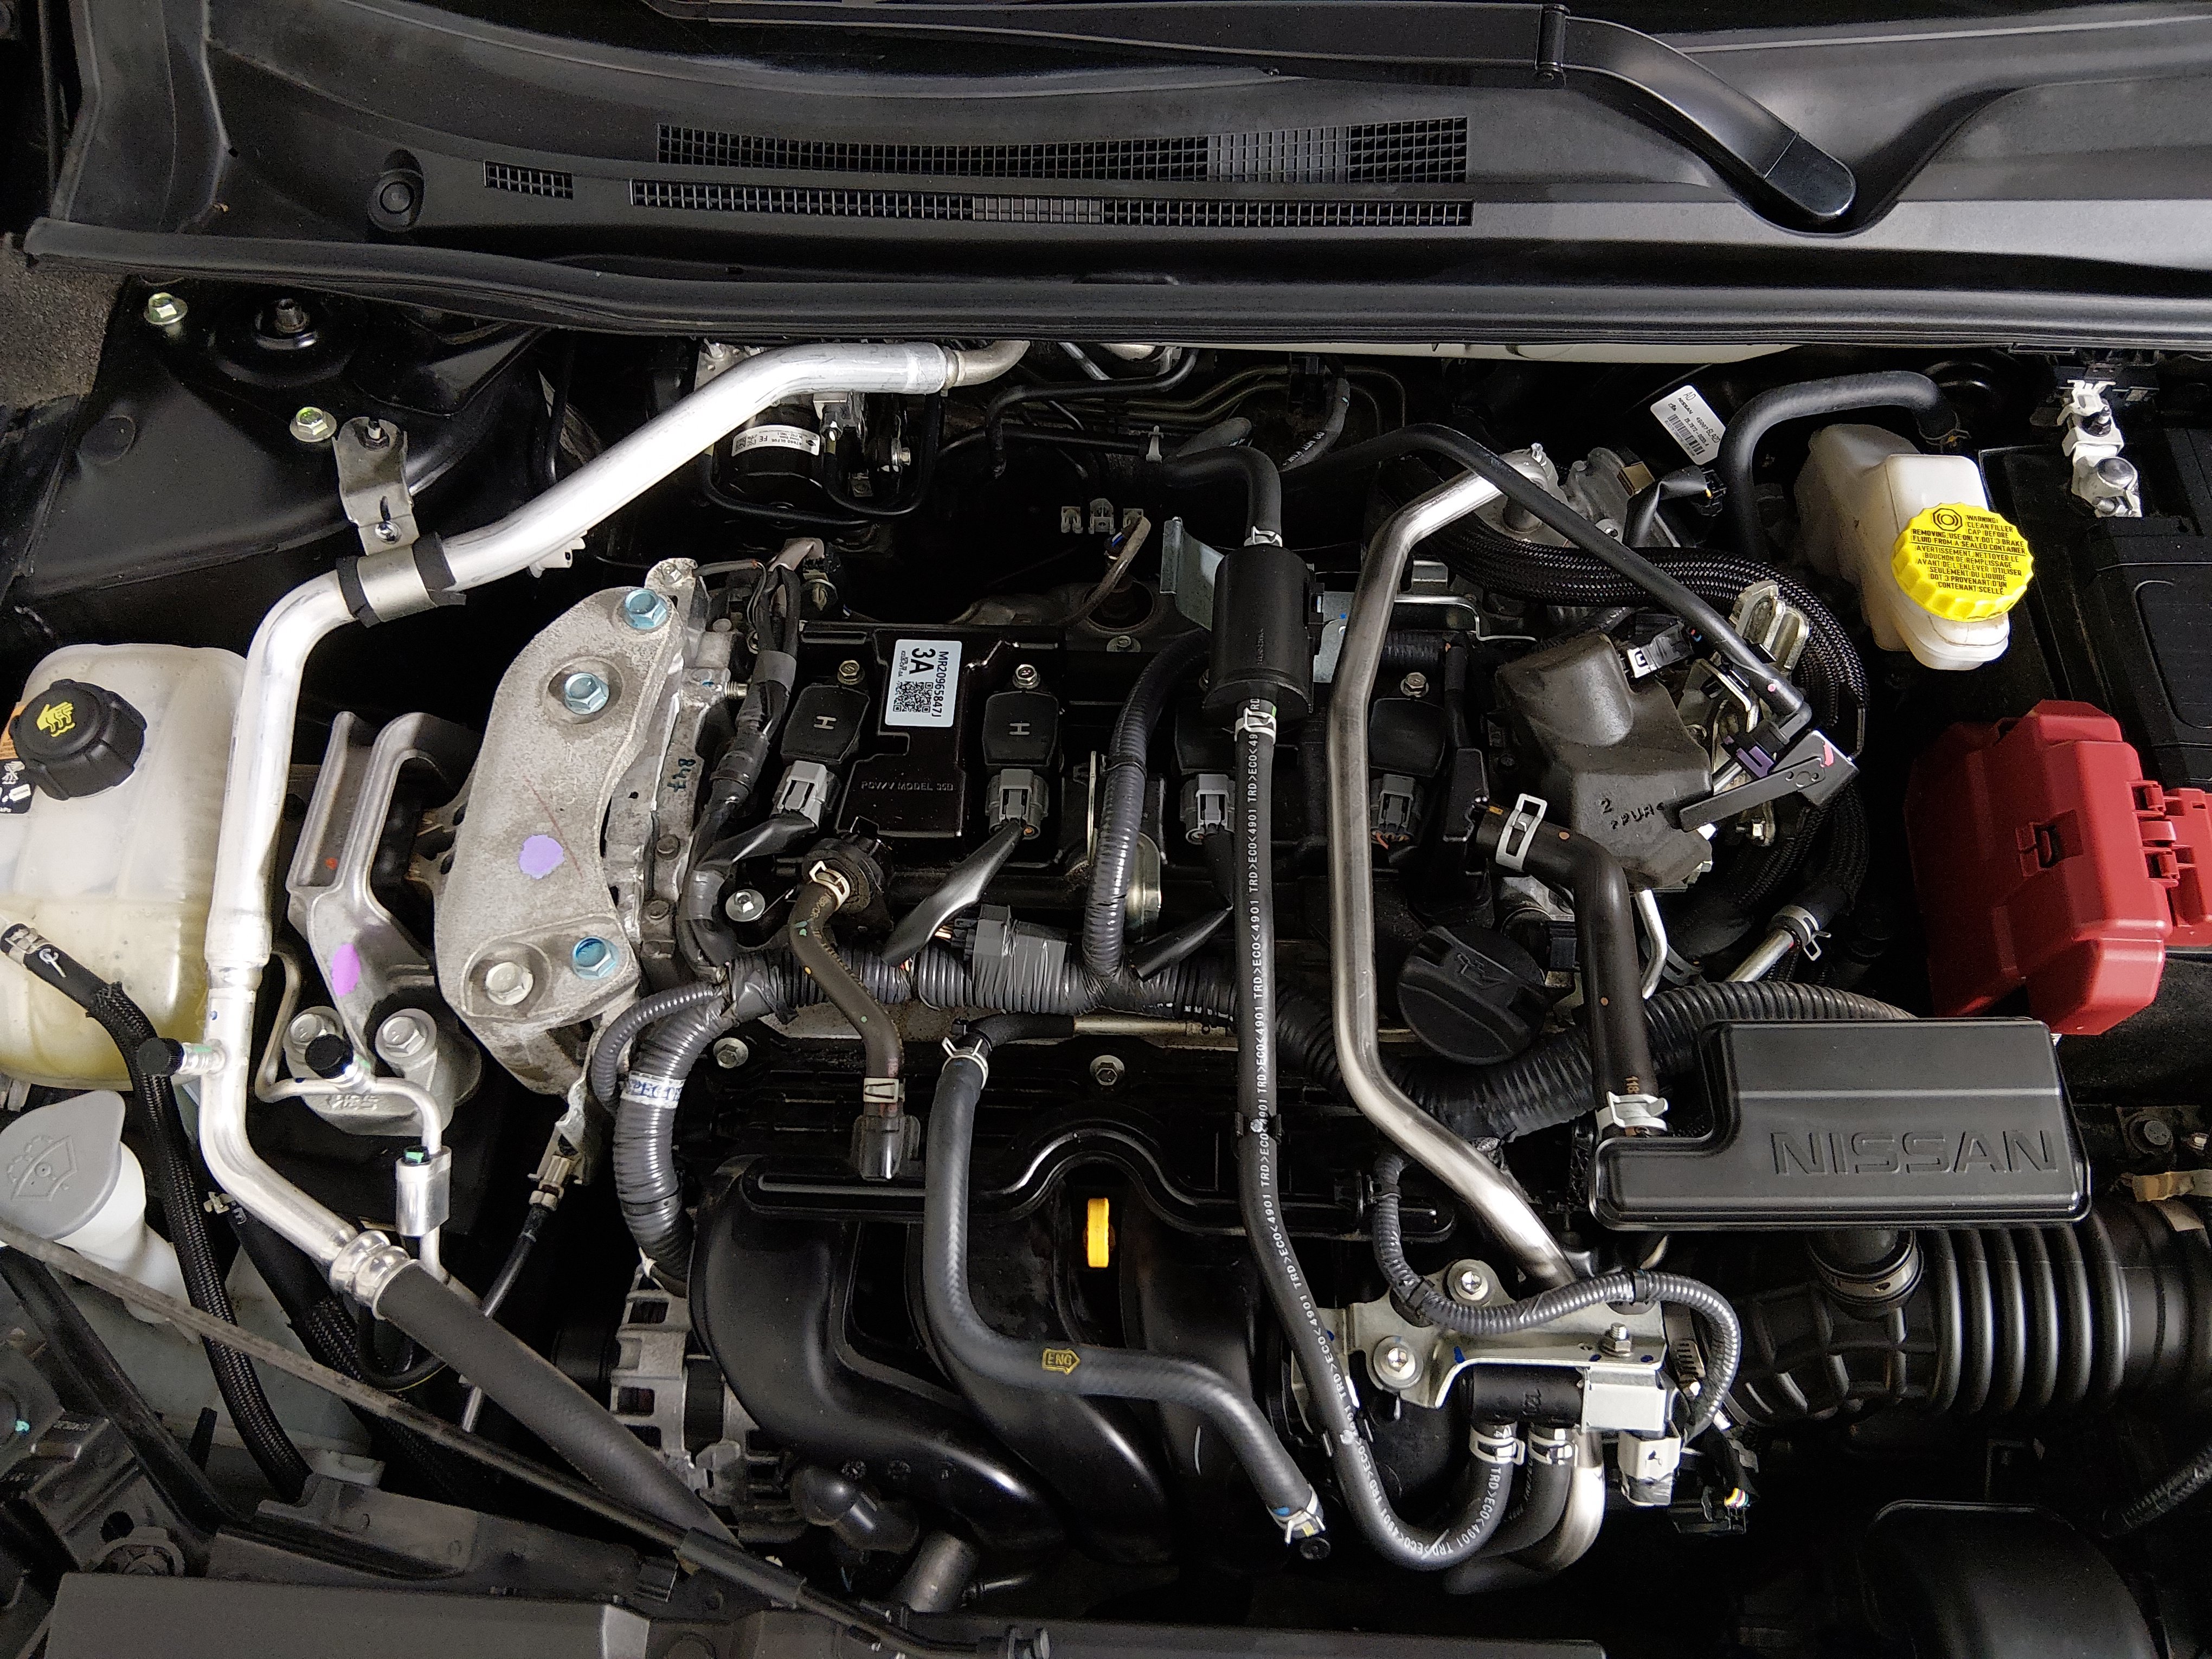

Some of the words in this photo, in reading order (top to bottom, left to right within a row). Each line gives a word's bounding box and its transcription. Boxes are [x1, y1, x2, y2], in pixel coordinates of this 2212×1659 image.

[1677, 397, 1693, 415] NISSAN
[1984, 530, 2009, 539] BEFORE
[1991, 524, 2014, 532] FILLER
[1912, 535, 1932, 543] FLUID
[1962, 541, 1988, 550] SEALED
[2002, 539, 2024, 548] BRAKE
[1925, 552, 1954, 562] BOUCHON
[1966, 557, 2012, 569] REMPLISSAGE
[1975, 551, 2009, 561] NETTOYER
[1917, 558, 1940, 567] AVANT
[1993, 567, 2022, 576] UTILISER
[1930, 566, 1969, 577] SEULEMENT
[1981, 572, 2007, 581] LIQUIDE
[1938, 581, 1977, 592] CONTENANT
[909, 647, 936, 675] 3A
[898, 781, 933, 791] MODEL
[1601, 798, 1614, 815] 2
[1248, 808, 1259, 893] TRD>ECO<4901
[1249, 899, 1263, 1001] TRD>ECO<4901
[1770, 1129, 2060, 1176] NISSAN
[1047, 1352, 1072, 1366] ENG
